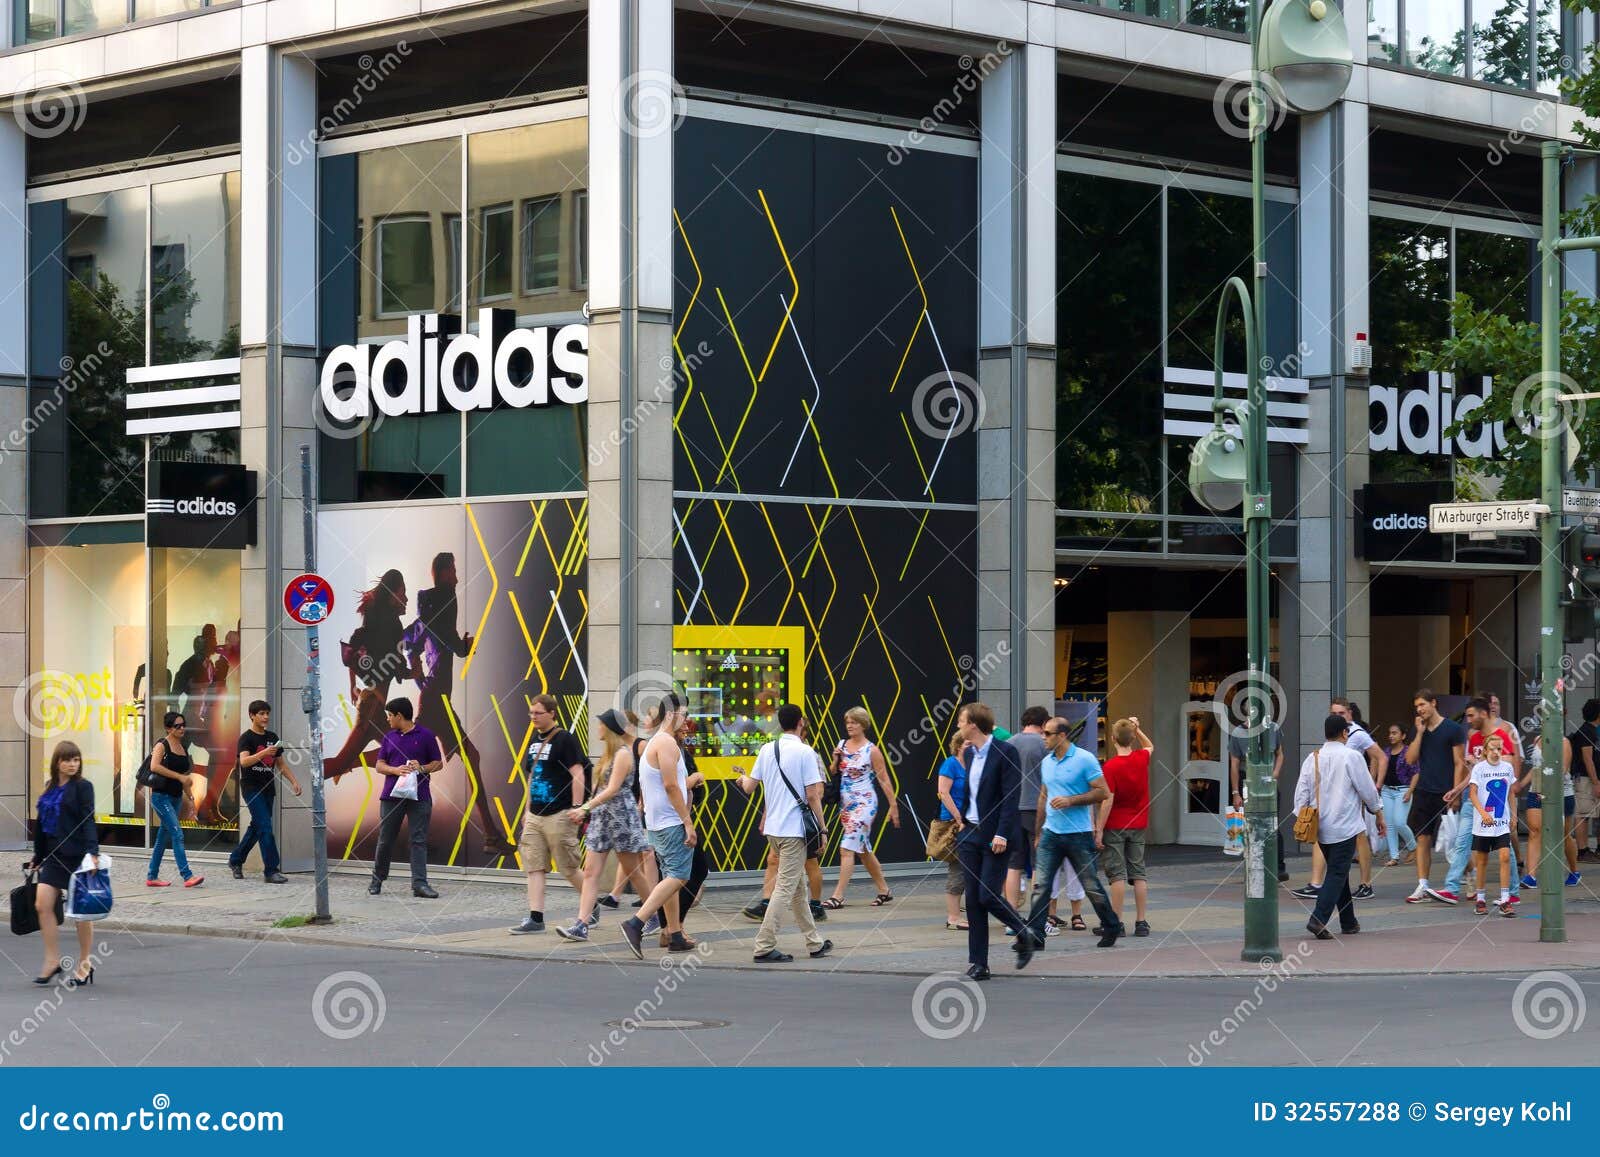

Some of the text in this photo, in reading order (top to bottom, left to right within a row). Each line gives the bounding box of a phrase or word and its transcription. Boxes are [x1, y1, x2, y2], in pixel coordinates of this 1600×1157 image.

[321, 307, 588, 421] adidas
[176, 496, 237, 516] adidas
[1438, 507, 1530, 525] Marburger Straße
[1372, 513, 1428, 530] adidas
[98, 703, 138, 732] run
